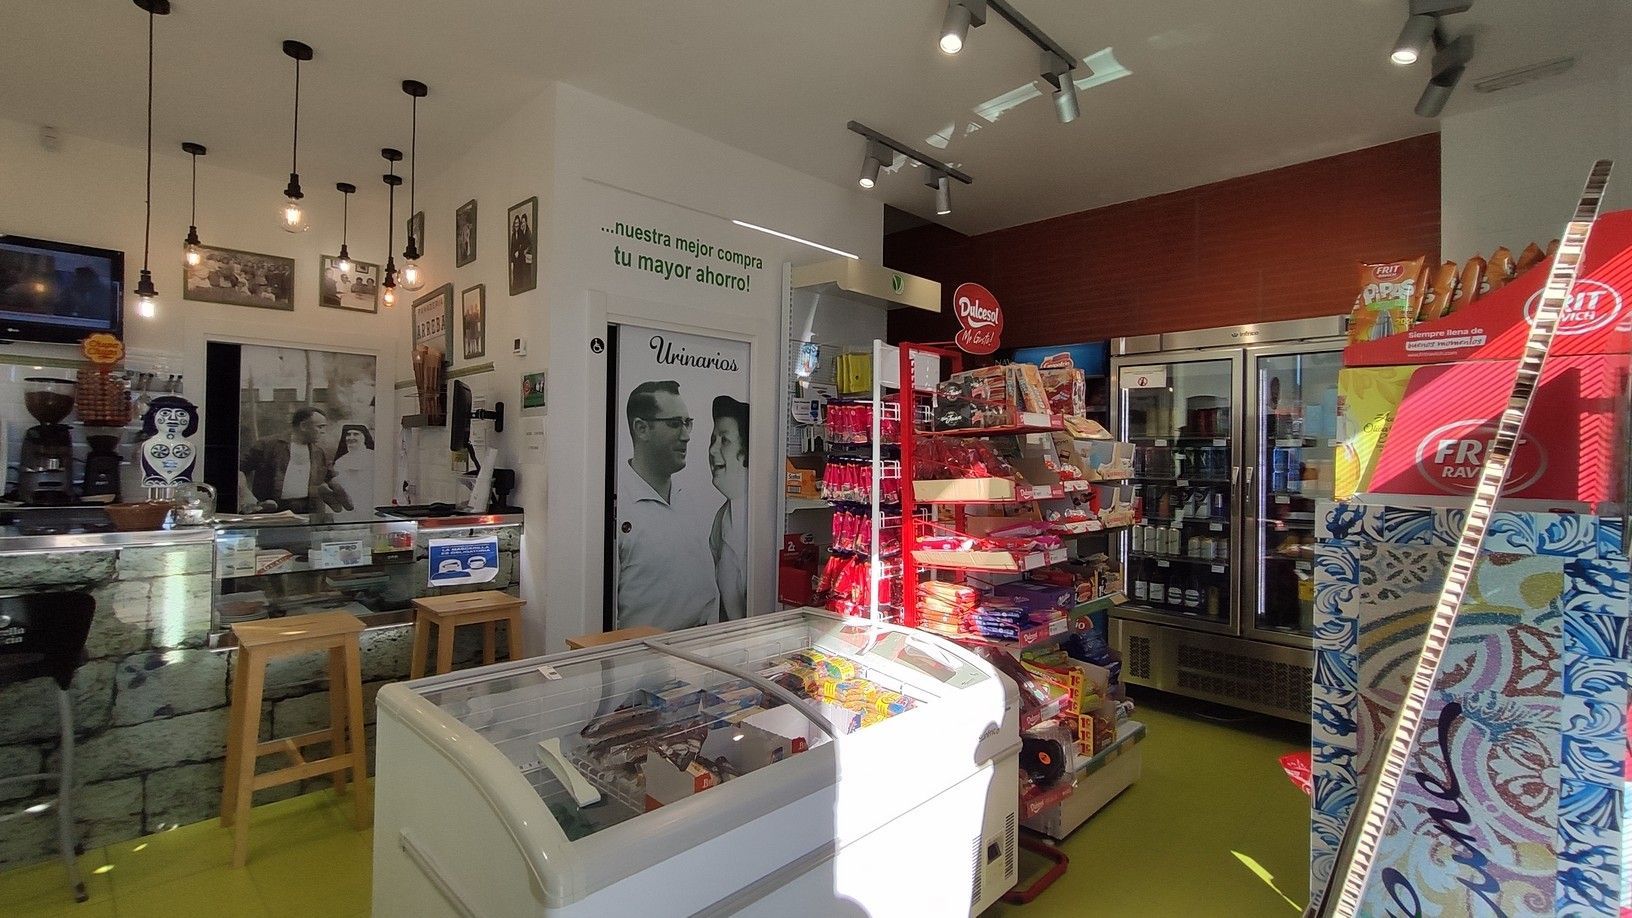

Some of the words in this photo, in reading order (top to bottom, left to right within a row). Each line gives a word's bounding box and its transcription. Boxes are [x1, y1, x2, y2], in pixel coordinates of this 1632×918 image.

[601, 222, 671, 247] ...nuestra
[676, 237, 714, 258] mejor
[717, 248, 763, 270] compra
[614, 245, 632, 267] tu
[638, 254, 691, 280] mayor
[696, 265, 750, 292] ahorro!
[959, 296, 999, 325] Dulcesol
[1565, 290, 1607, 312] RIT
[1408, 329, 1444, 339] Siempre
[650, 335, 739, 371] Urinarios
